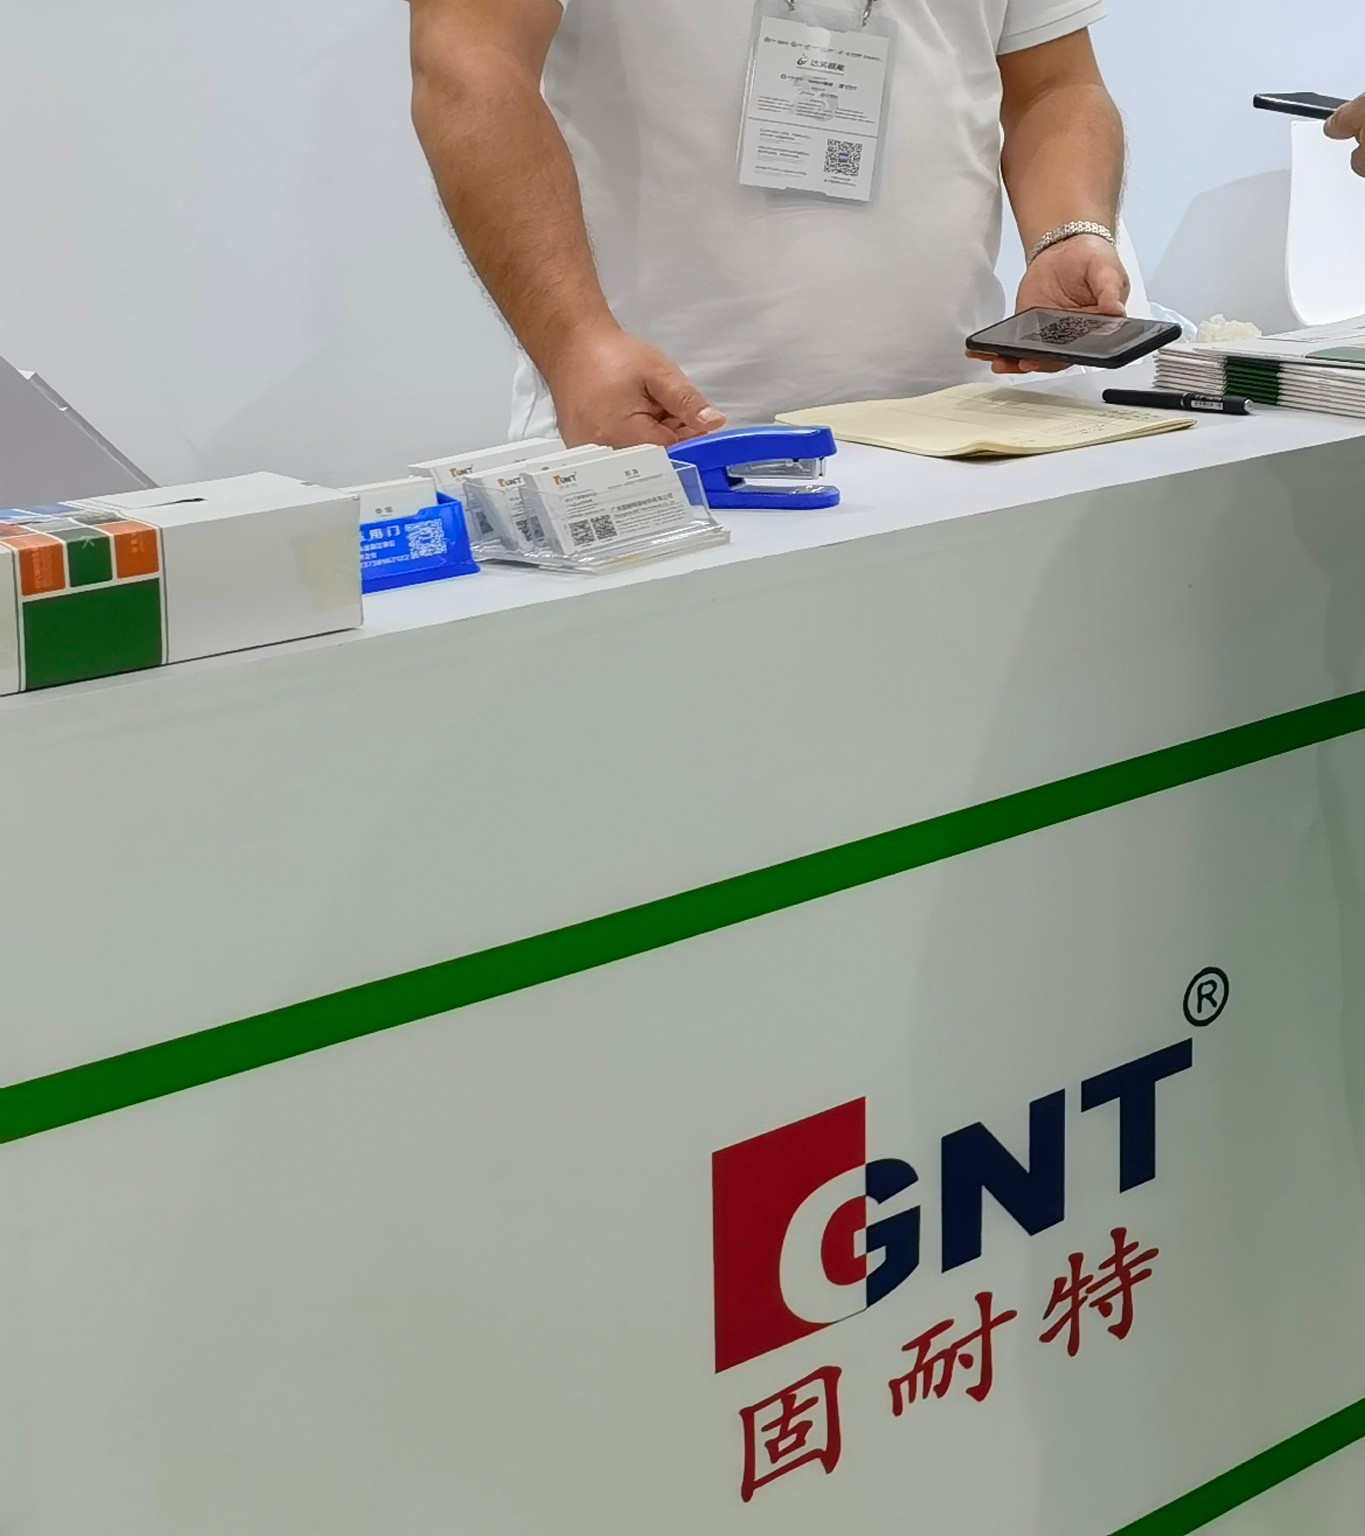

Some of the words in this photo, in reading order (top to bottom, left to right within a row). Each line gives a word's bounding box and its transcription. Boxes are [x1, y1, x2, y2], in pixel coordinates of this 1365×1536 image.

[778, 1037, 1193, 1324] GNT
[738, 1227, 1160, 1503] 固耐特
